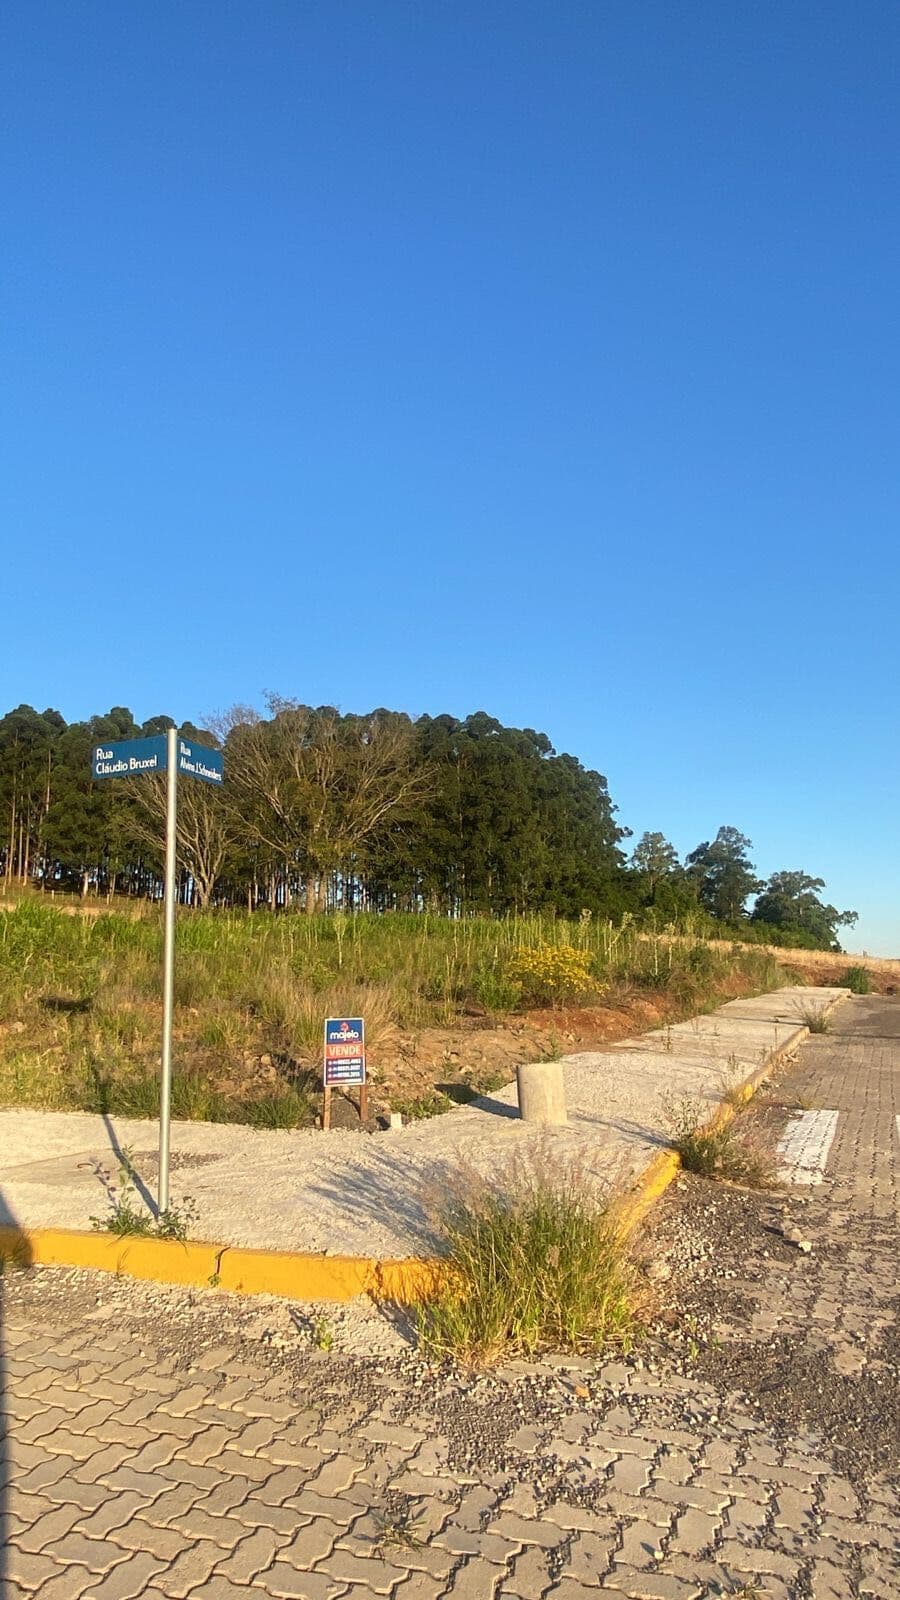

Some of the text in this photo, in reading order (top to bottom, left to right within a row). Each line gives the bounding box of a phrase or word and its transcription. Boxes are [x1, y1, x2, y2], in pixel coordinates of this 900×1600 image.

[96, 748, 113, 760] Rua
[180, 741, 191, 757] Rua
[95, 754, 158, 775] Cláudio Bruxel
[329, 1045, 360, 1056] VENDE
